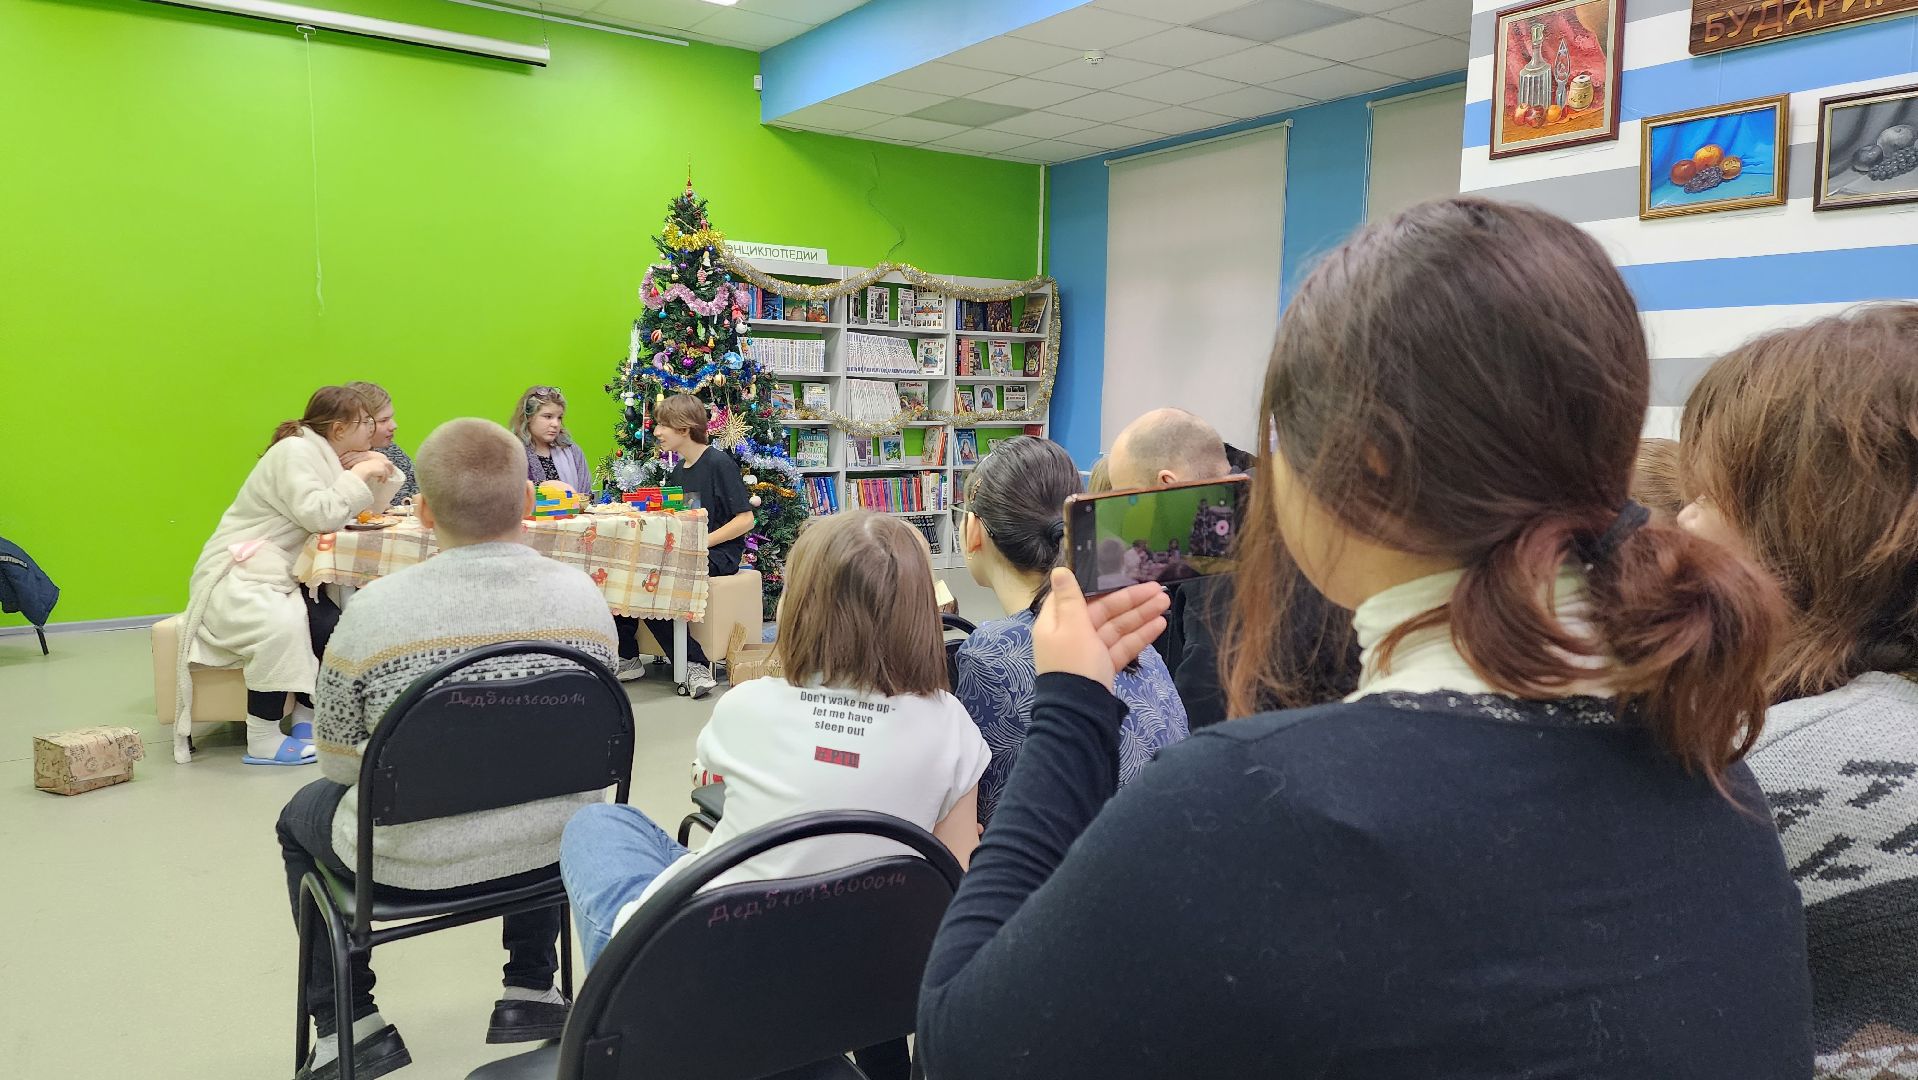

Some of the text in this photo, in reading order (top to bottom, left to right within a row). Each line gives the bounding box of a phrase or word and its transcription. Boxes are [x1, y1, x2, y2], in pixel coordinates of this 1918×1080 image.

[800, 691, 826, 704] Don't
[828, 696, 856, 708] wake
[858, 702, 875, 711] me
[876, 703, 890, 713] up
[812, 706, 874, 724] let me have
[814, 720, 865, 737] sleep out
